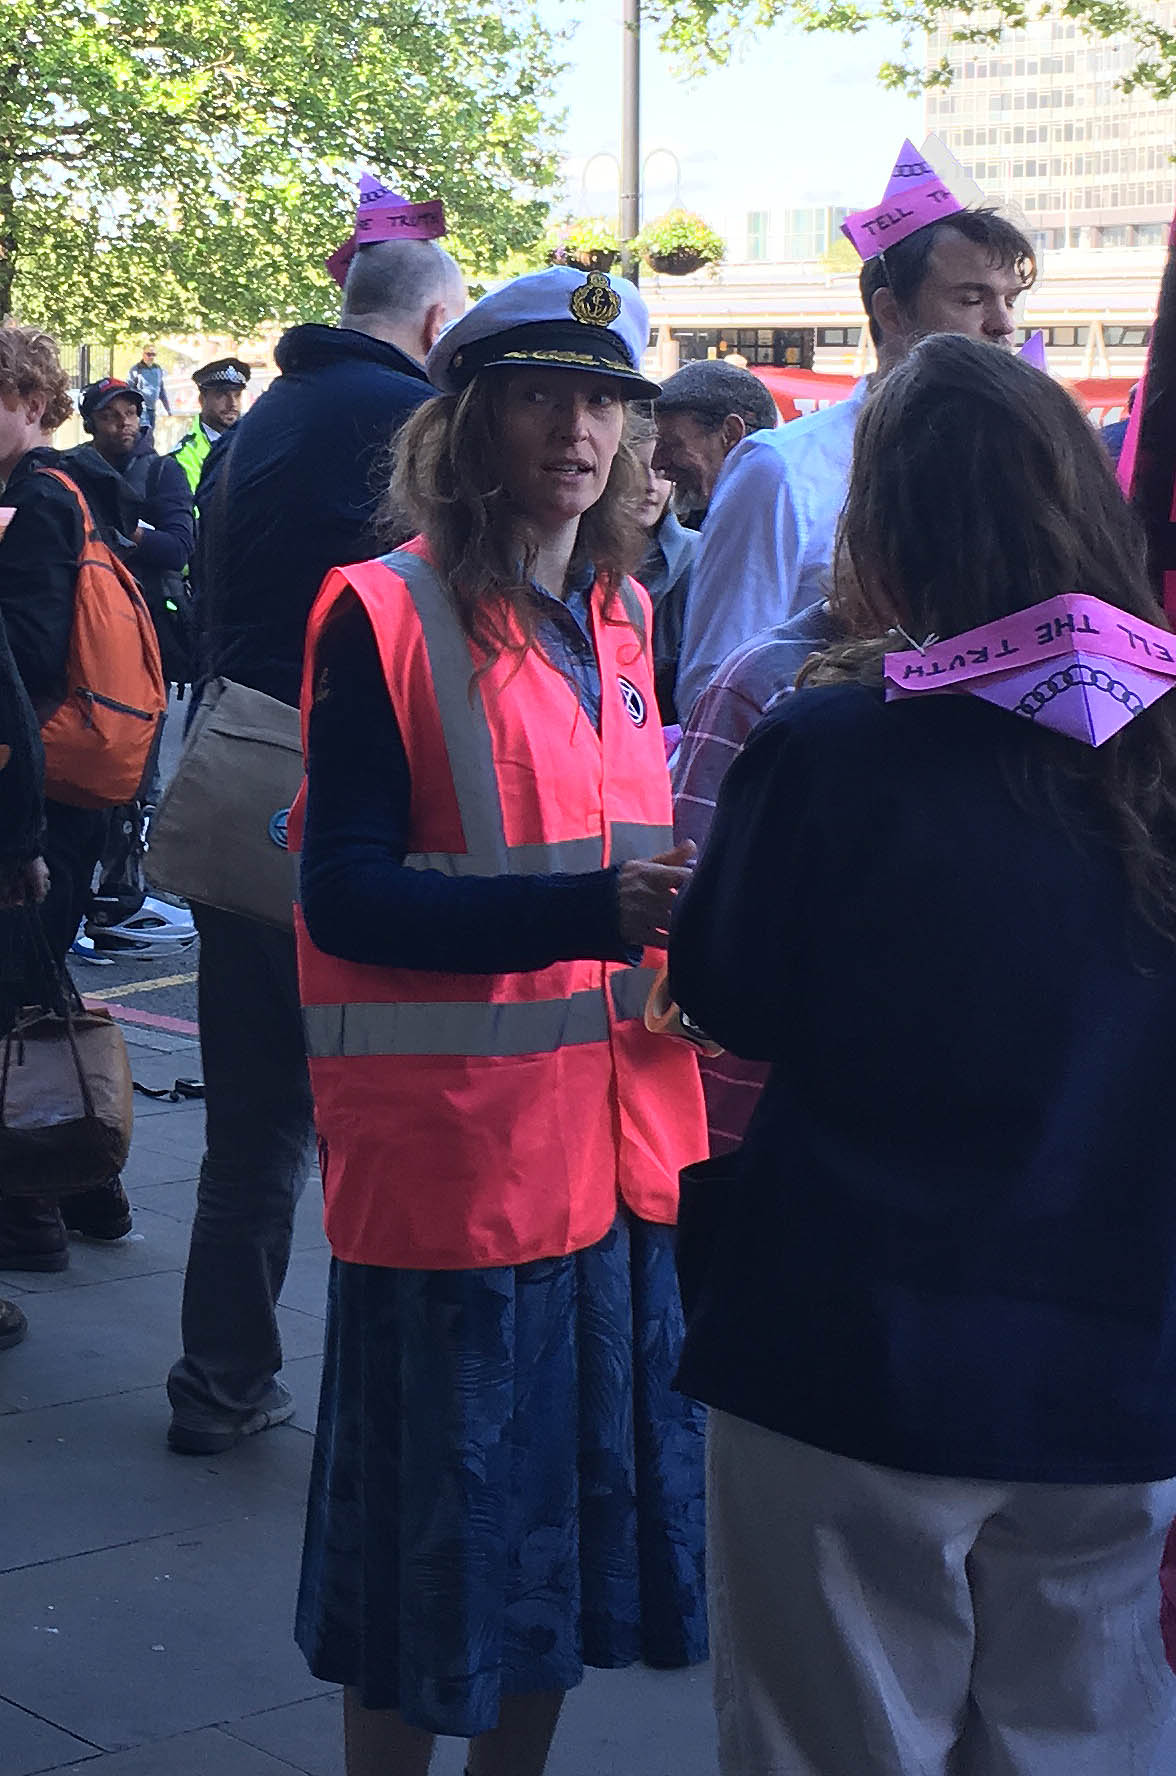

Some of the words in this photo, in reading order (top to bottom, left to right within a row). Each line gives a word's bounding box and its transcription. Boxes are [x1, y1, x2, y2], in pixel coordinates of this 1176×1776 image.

[861, 208, 914, 235] TELL
[1035, 614, 1100, 646] THE
[903, 639, 1020, 680] TRUTH
